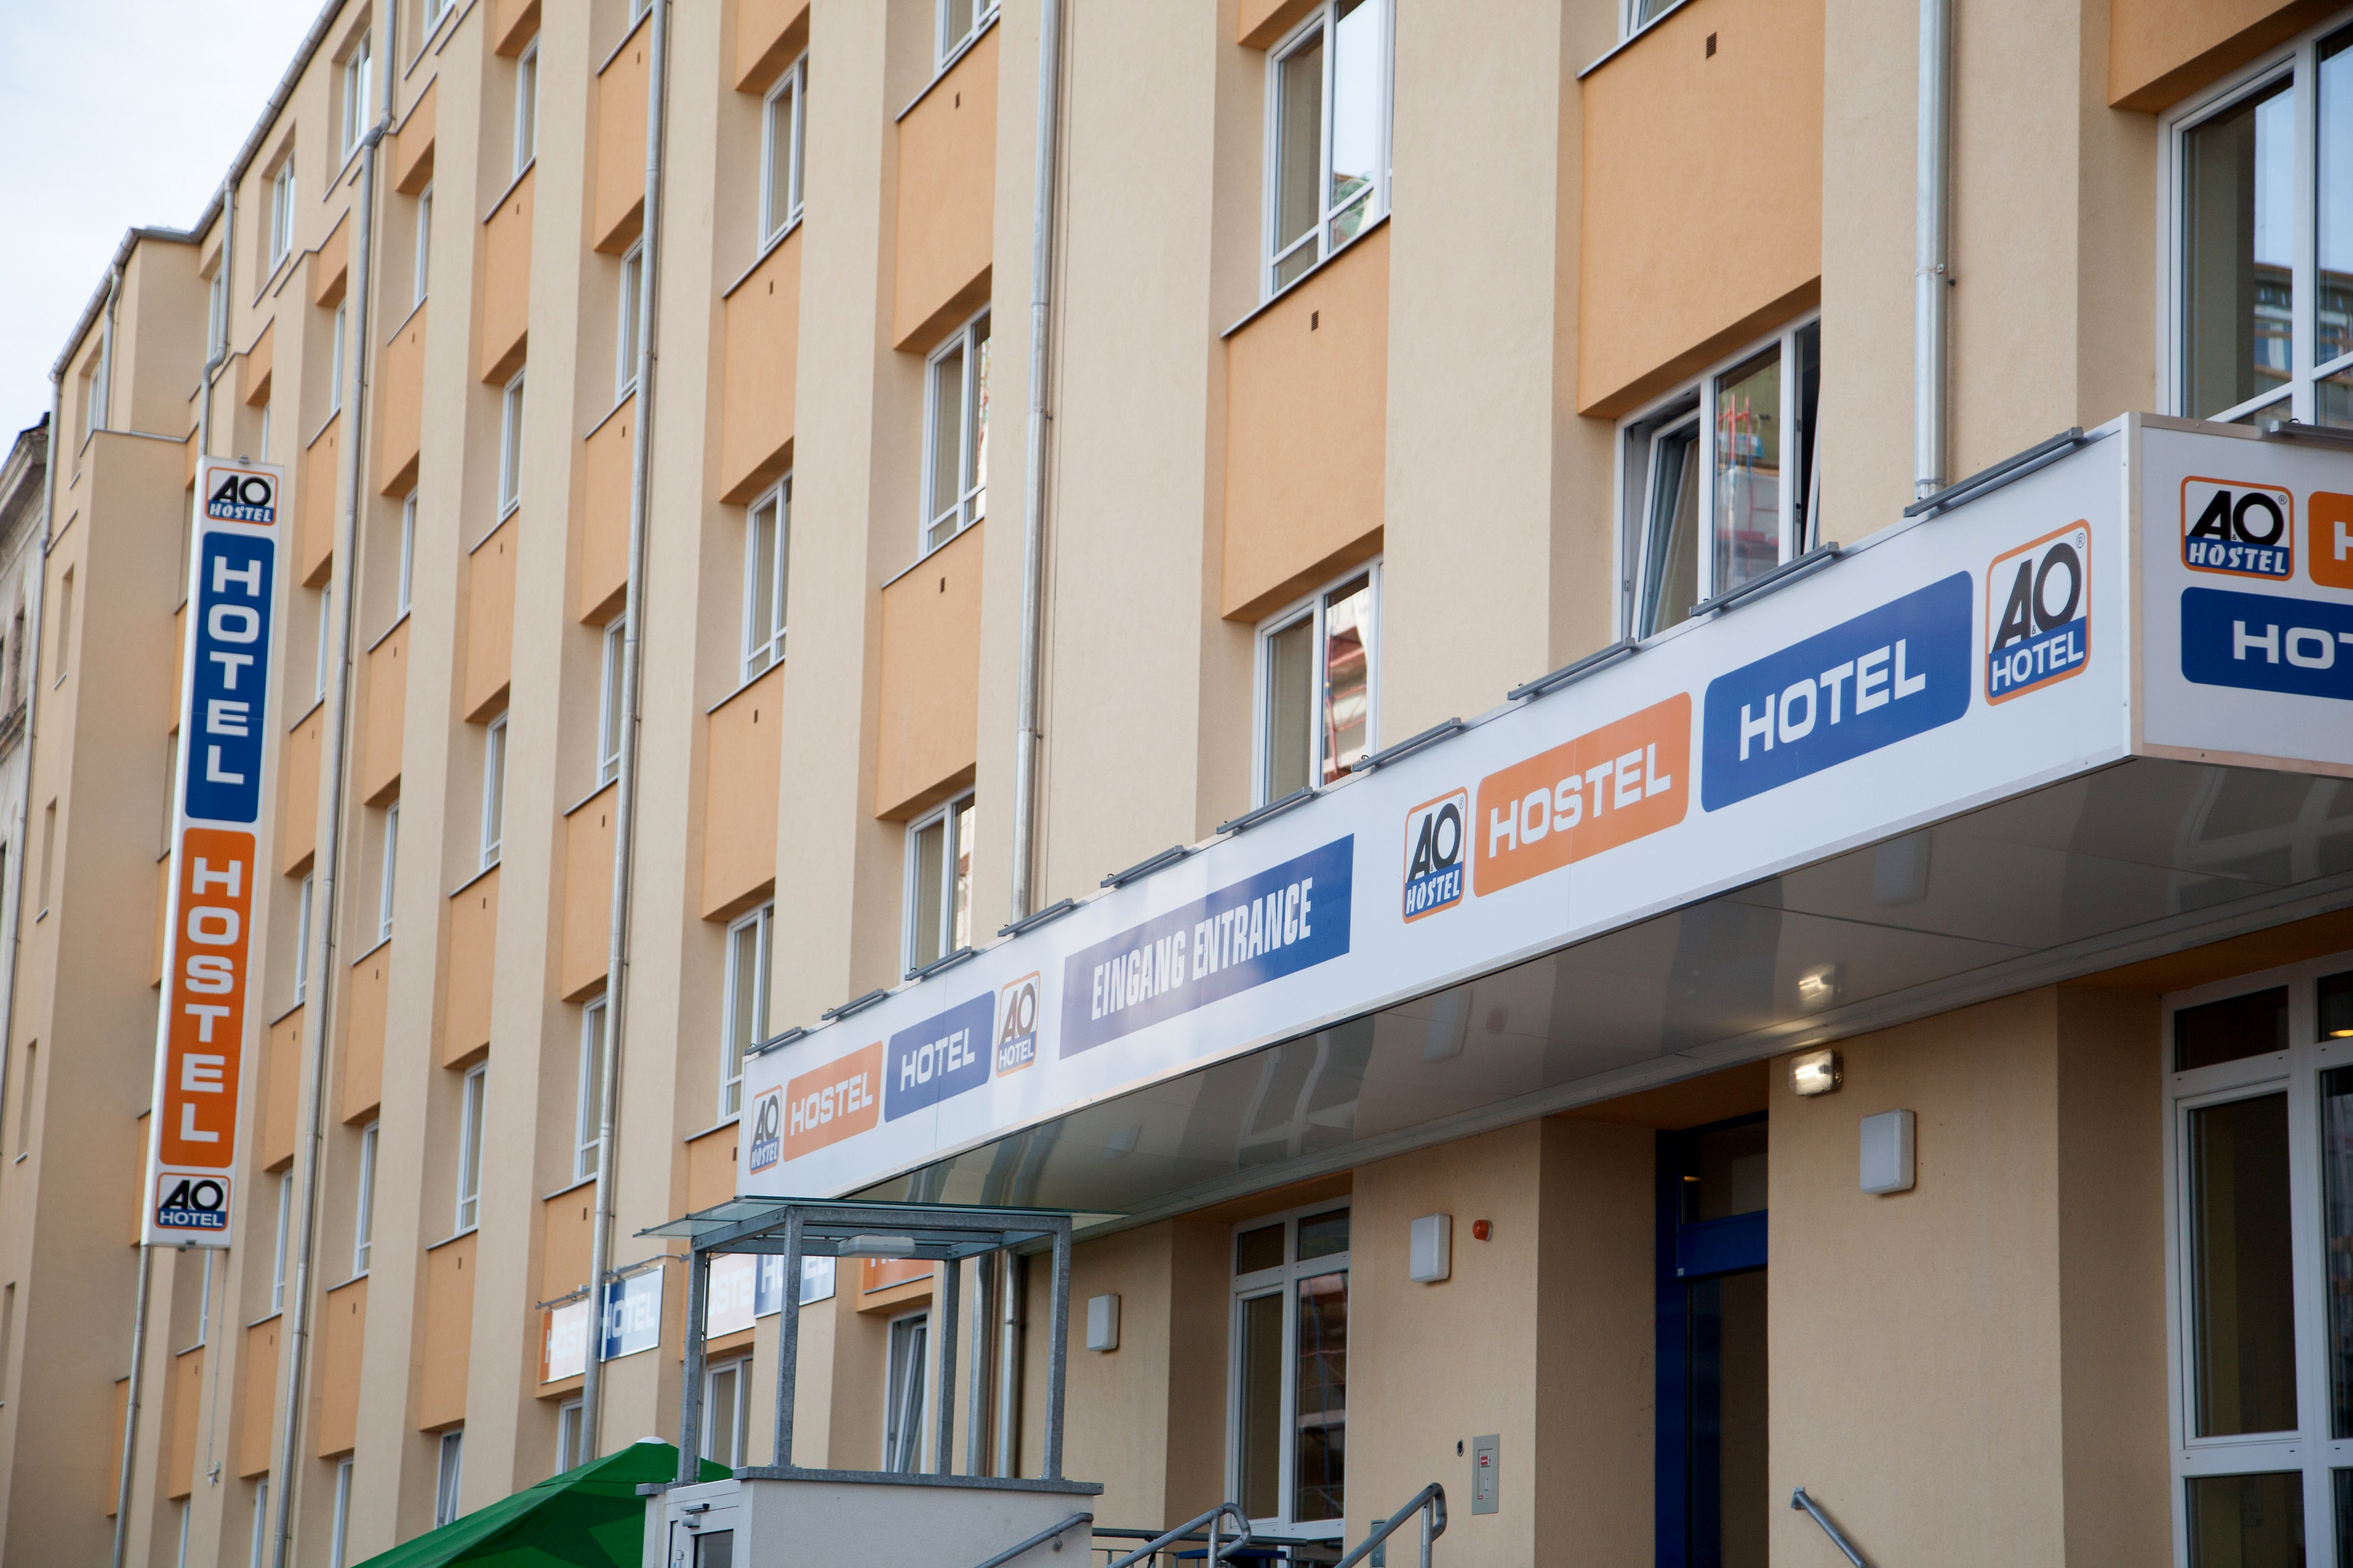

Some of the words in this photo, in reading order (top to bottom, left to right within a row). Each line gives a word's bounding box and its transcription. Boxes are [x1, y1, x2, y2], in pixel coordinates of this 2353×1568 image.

[209, 503, 271, 522] HOSTEL
[2189, 542, 2286, 573] HOSTEL
[206, 556, 261, 784] HOTEL
[1992, 631, 2083, 692] HOTEL
[1740, 638, 1926, 761] HOTEL
[1489, 742, 1671, 858] HOSTEL
[1406, 870, 1460, 914] HOSTEL
[1092, 930, 1186, 1021] EINGANG
[1193, 877, 1313, 981] ENTRANCE
[180, 857, 242, 1143] HOSTEL
[900, 1028, 975, 1091] HOTEL
[998, 1038, 1034, 1069] HOTEL
[790, 1072, 873, 1136] HOSTEL
[751, 1141, 778, 1169] HOSTEL
[159, 1211, 223, 1227] HOTEL
